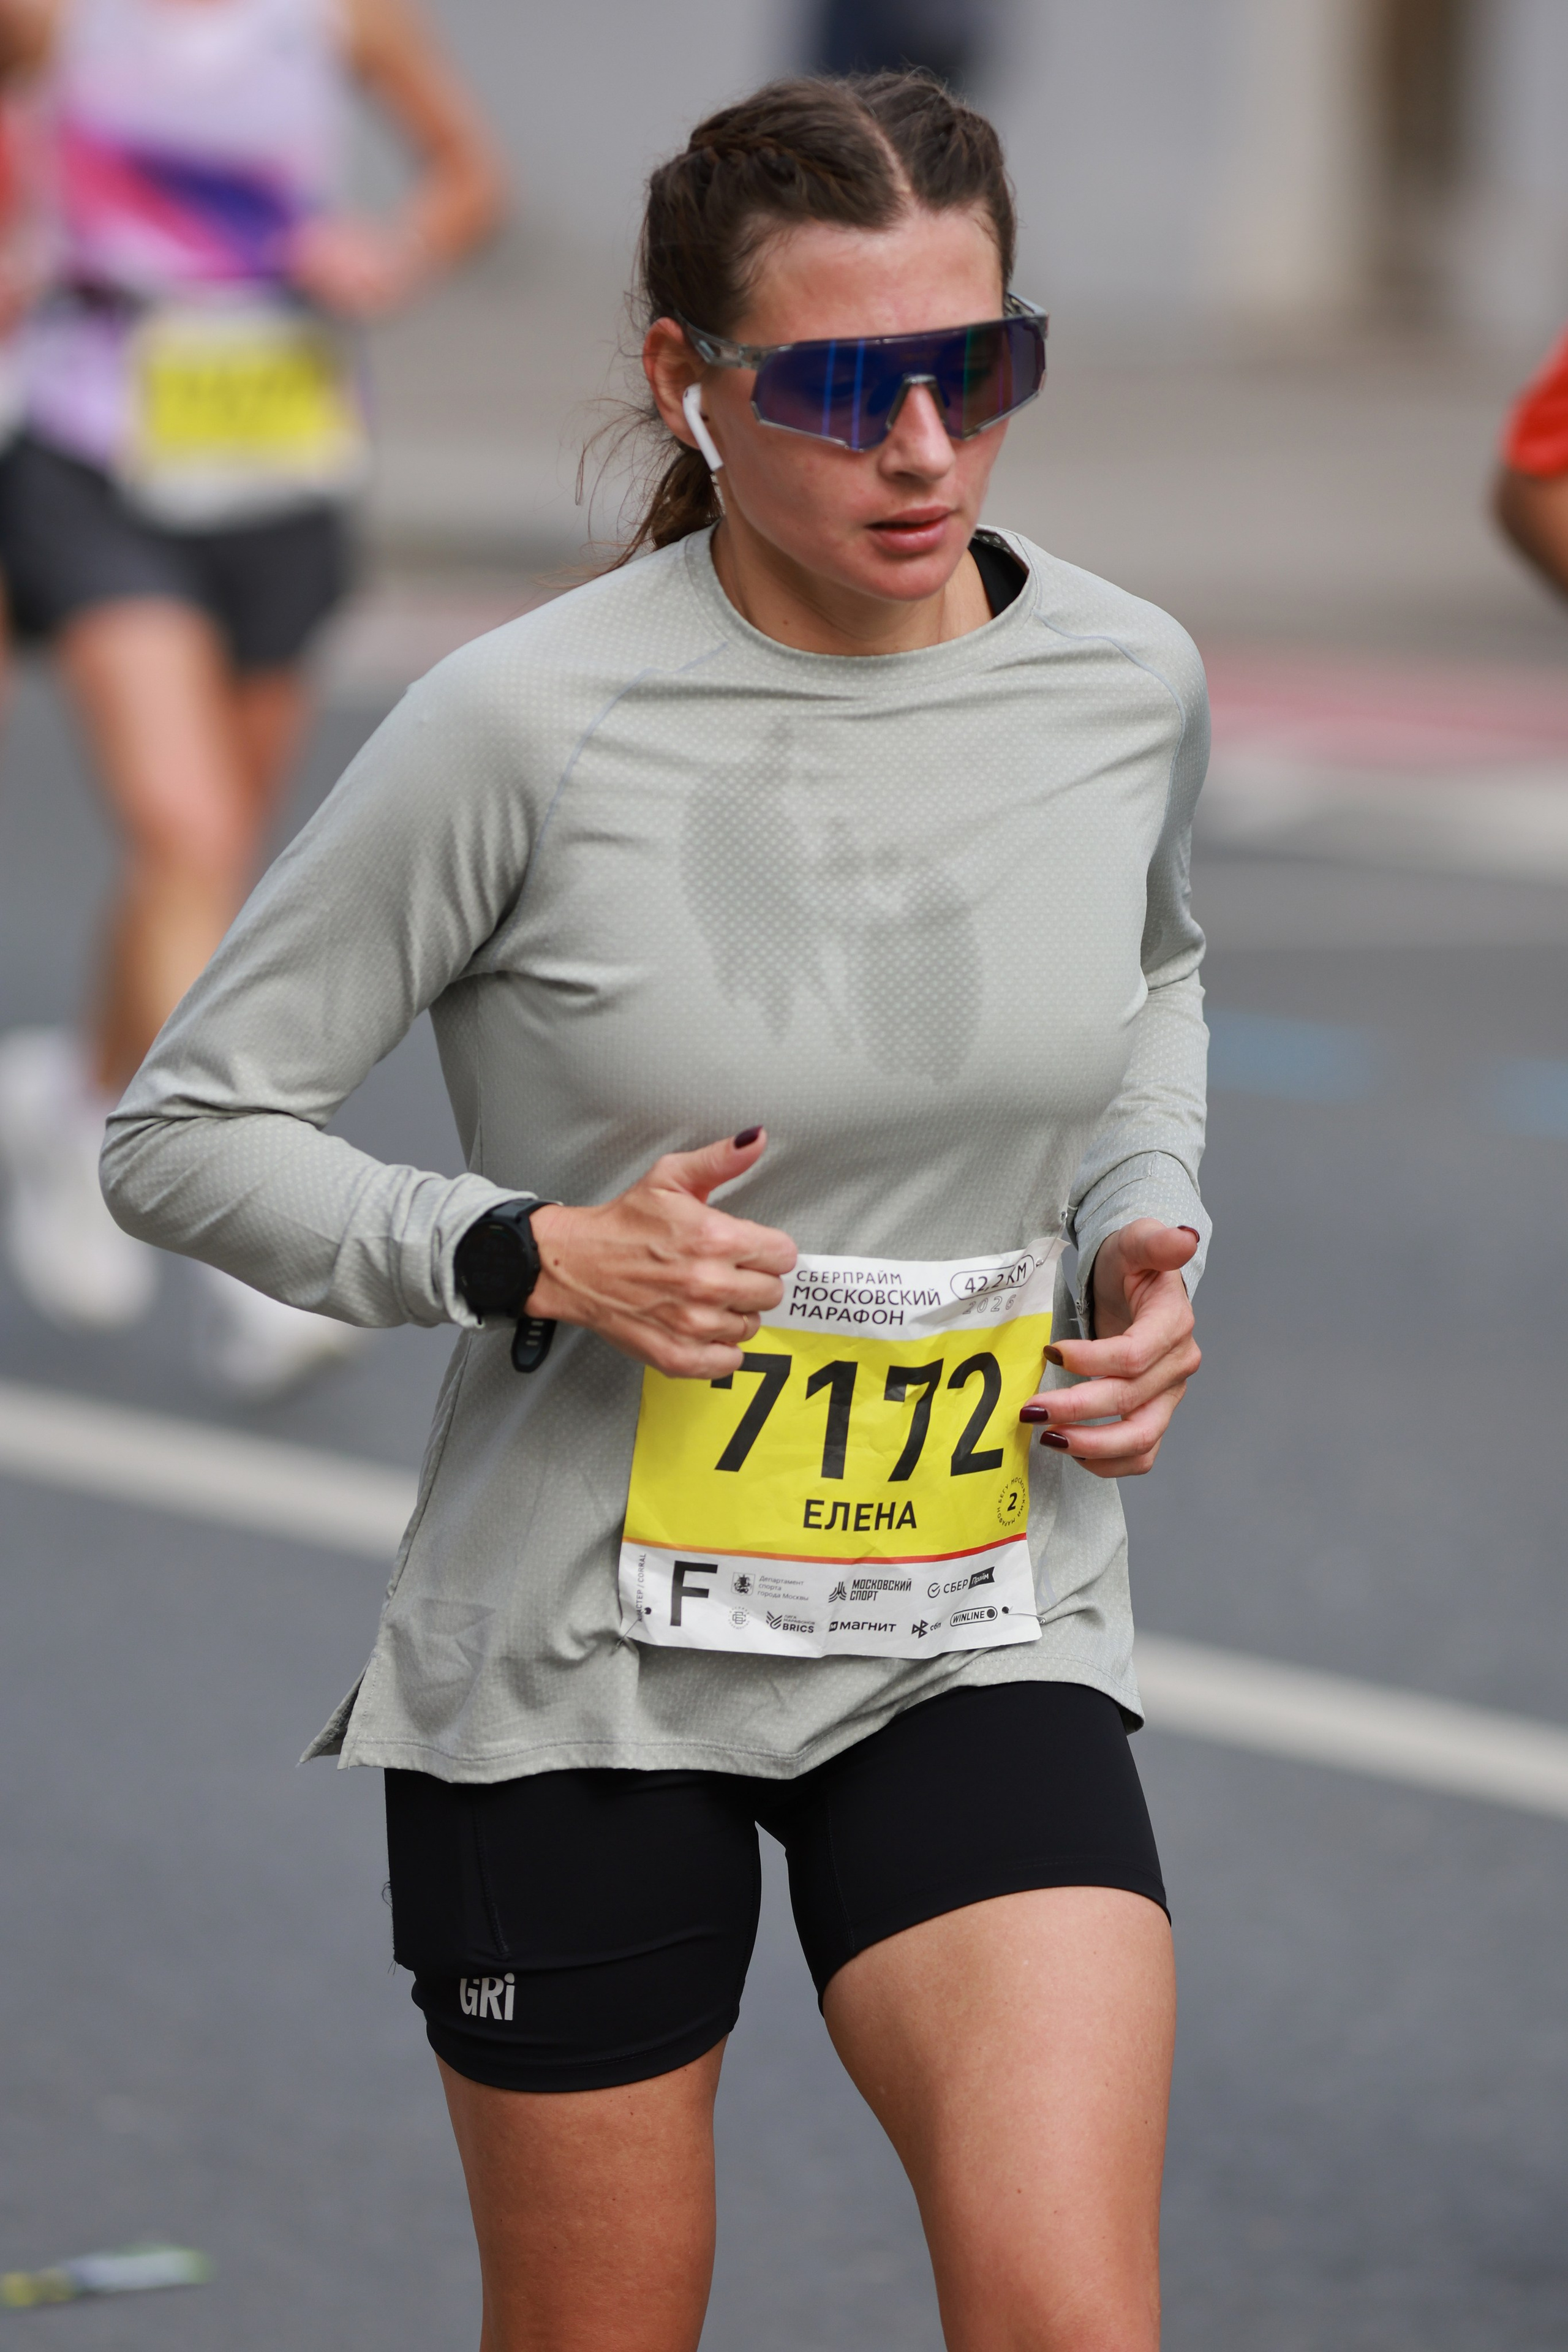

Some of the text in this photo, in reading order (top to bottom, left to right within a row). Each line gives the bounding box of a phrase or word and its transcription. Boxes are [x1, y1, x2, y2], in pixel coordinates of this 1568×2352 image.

[797, 1270, 902, 1284] СБЕРПРАЙМ
[793, 1285, 941, 1305] МОСКОВСКИЙ
[962, 1295, 1016, 1314] 2026
[789, 1303, 903, 1325] МАРАФОН
[710, 1352, 1003, 1482] 7172
[1007, 1492, 1017, 1512] 2
[803, 1499, 917, 1531] ЕЛЕНА
[638, 1553, 646, 1583] CORRAL
[759, 1575, 804, 1585] Департамент
[852, 1578, 911, 1591] МОСКОВСКИЙ
[944, 1579, 968, 1594] СБЕР
[670, 1560, 718, 1626] F
[850, 1591, 878, 1601] СПОРТ
[953, 1611, 985, 1624] WINLINE
[783, 1623, 814, 1633] BRICS
